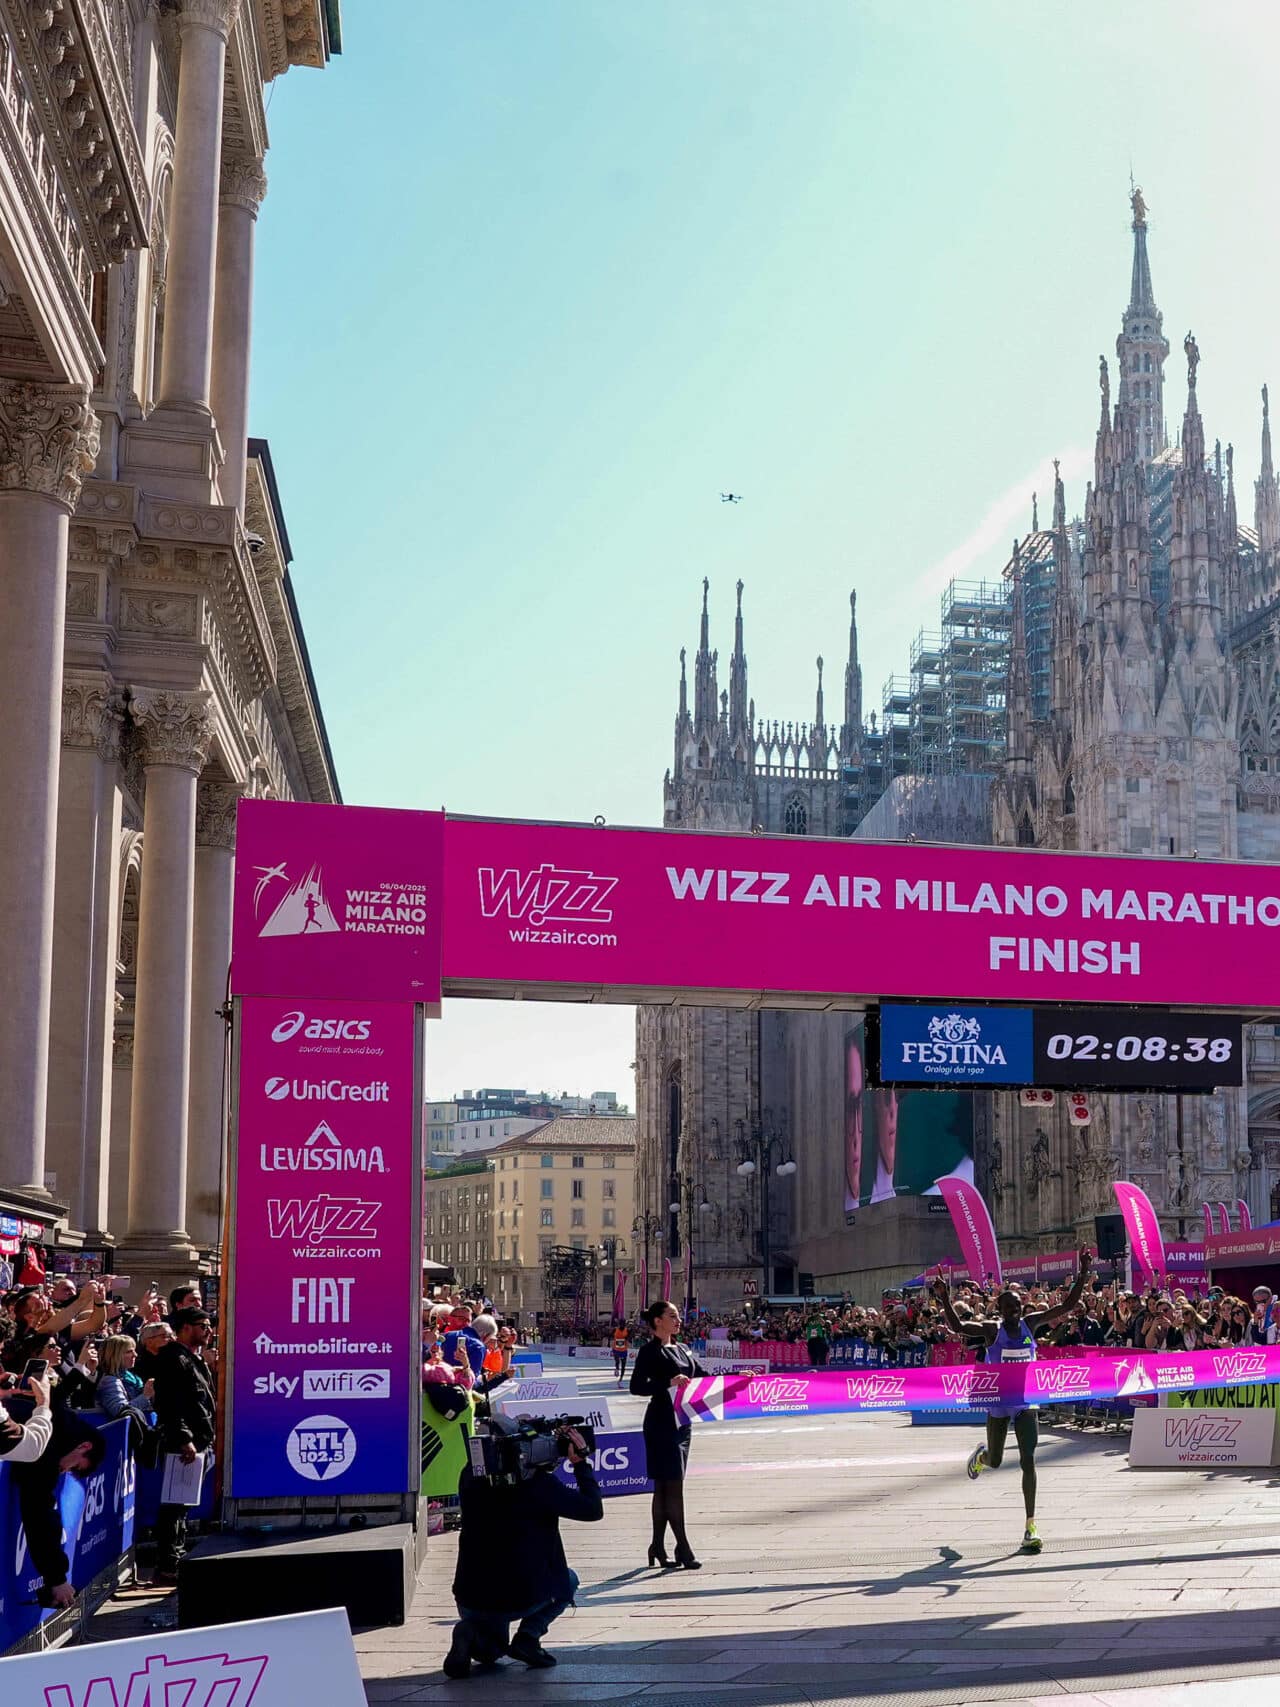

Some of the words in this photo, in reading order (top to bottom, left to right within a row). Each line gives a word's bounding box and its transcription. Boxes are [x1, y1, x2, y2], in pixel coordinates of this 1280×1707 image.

[346, 889, 393, 904] WIZZ
[397, 892, 426, 906] AIR
[665, 867, 791, 904] WIZZ
[803, 873, 881, 910] AIR
[895, 879, 1068, 918] MILANO
[345, 905, 427, 923] MILANO
[345, 921, 425, 935] MARATHON
[509, 928, 618, 947] wizzair.com
[988, 935, 1142, 976] FINISH
[902, 1042, 1008, 1065] FESTINA
[1046, 1034, 1233, 1063] 02:08:38
[924, 1064, 952, 1075] Orologi
[953, 1065, 967, 1075] dal
[967, 1067, 985, 1076] 1902
[292, 1079, 390, 1103] UniCredit
[260, 1144, 386, 1173] LEVISSIMA
[293, 1245, 382, 1259] wizzair.com
[1167, 1252, 1186, 1261] AIR
[291, 1277, 355, 1324] FIAT
[253, 1332, 393, 1354] immobiliare.it
[1155, 1367, 1178, 1375] WIZZ
[1157, 1373, 1195, 1384] MILANO
[253, 1371, 300, 1398] sky
[308, 1373, 354, 1392] wifi
[955, 1394, 1001, 1404] wizzair.com
[1049, 1389, 1092, 1399] wizzair.com
[1203, 1385, 1255, 1408] WORLD
[761, 1403, 809, 1413] wizzair.com
[859, 1399, 906, 1408] wizzair.com
[300, 1432, 344, 1450] RTL
[300, 1451, 345, 1463] 102.5
[1178, 1452, 1238, 1462] wizzair.com
[606, 1475, 629, 1486] sound
[629, 1475, 648, 1487] body
